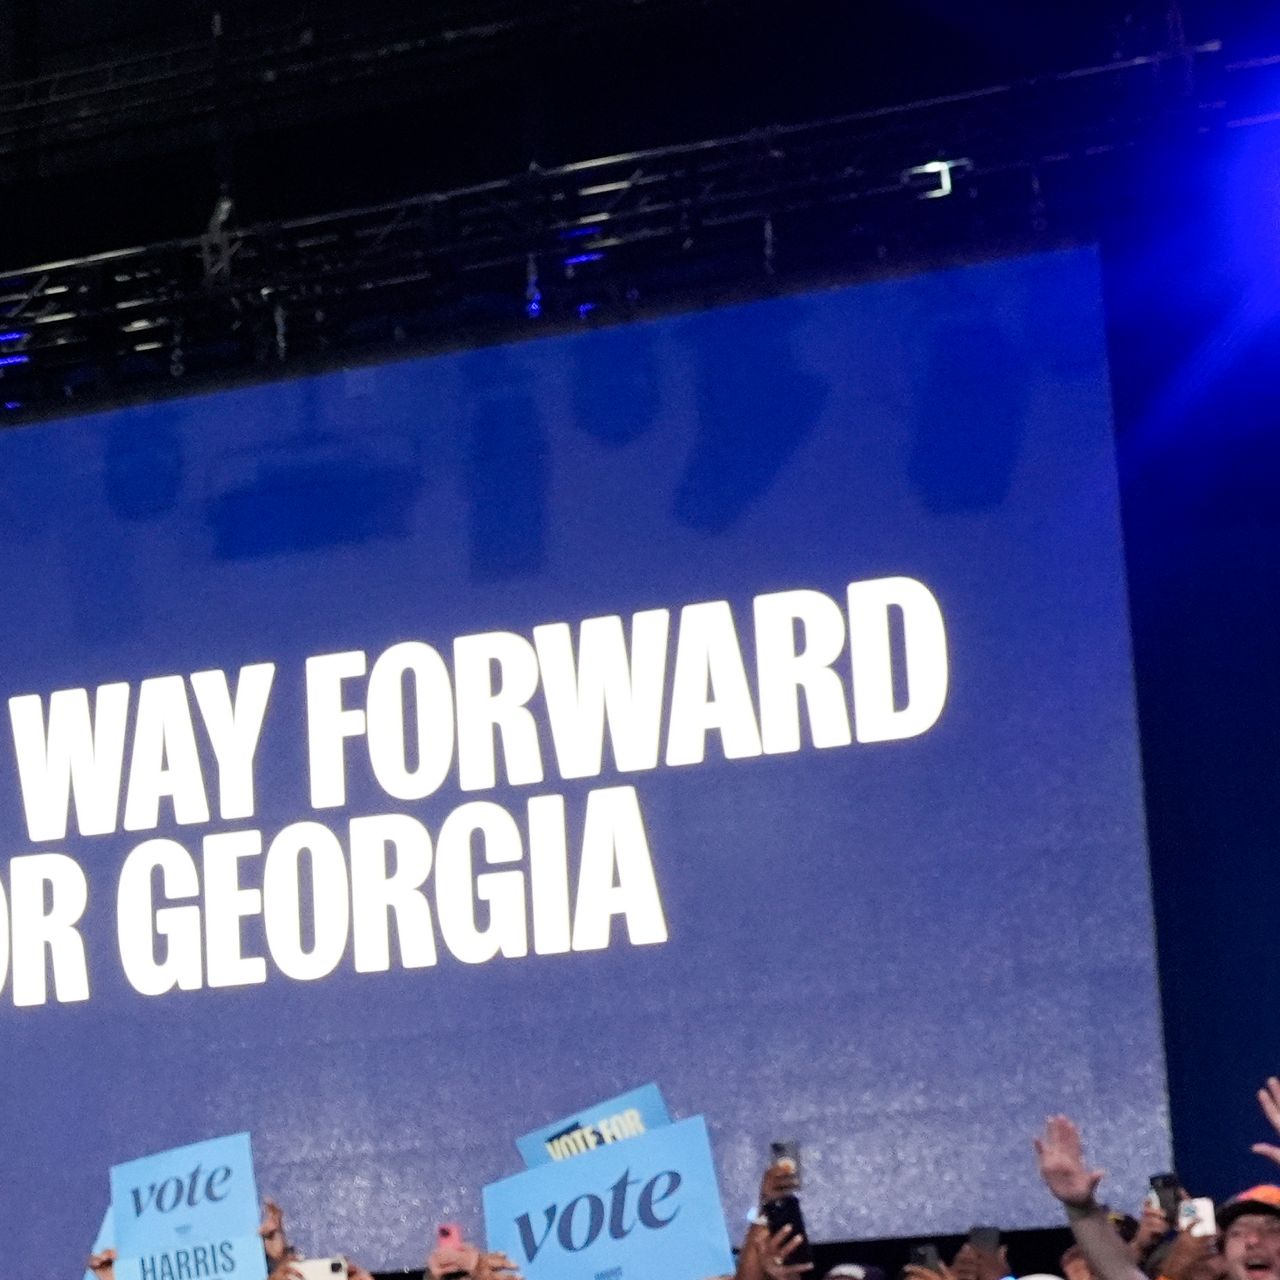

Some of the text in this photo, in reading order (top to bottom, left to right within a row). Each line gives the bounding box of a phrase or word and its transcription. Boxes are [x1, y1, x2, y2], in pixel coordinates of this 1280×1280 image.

[8, 662, 275, 842] WAY
[305, 576, 949, 809] FORWARD
[116, 785, 668, 996] GEORGIA
[545, 1108, 645, 1162] VOTE FOR
[130, 1163, 232, 1217] vote
[514, 1166, 681, 1263] vote
